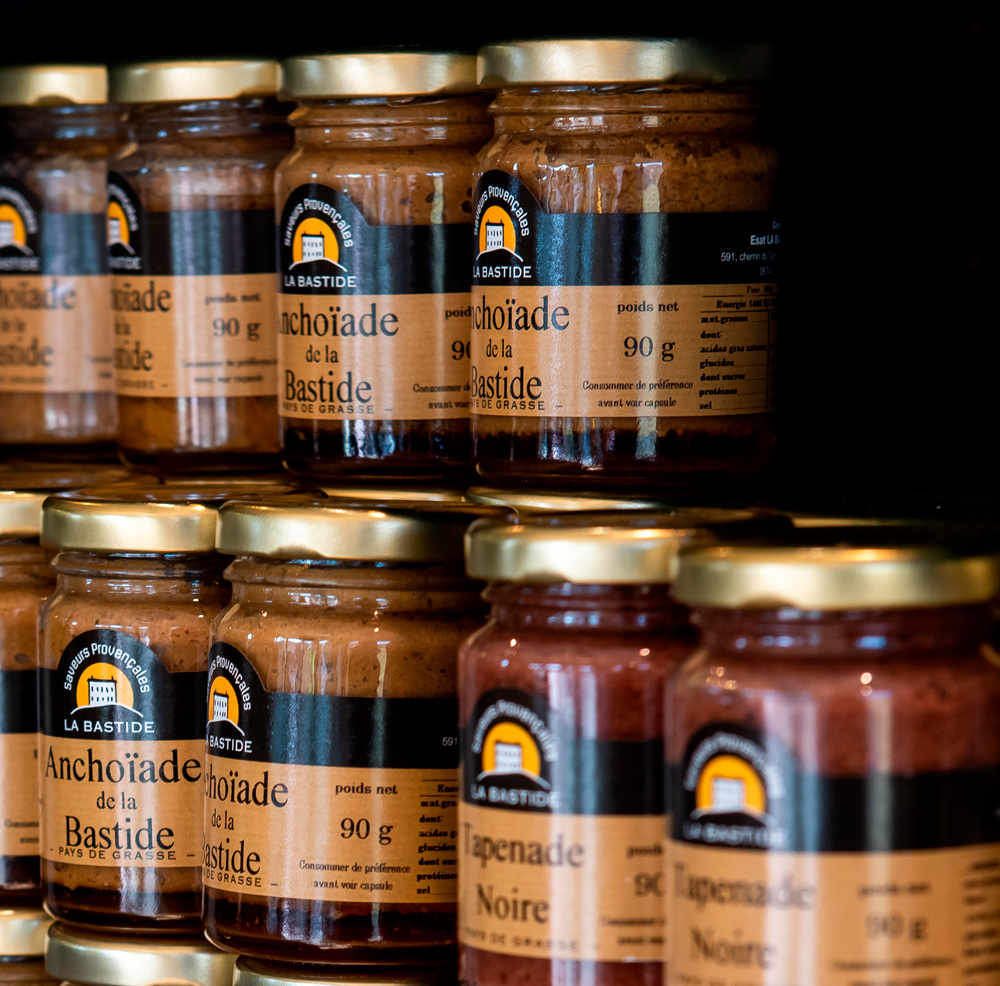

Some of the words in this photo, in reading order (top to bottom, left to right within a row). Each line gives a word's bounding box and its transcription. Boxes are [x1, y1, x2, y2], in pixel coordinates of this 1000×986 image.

[482, 266, 532, 278] BASTIDE
[284, 275, 296, 287] LA
[298, 276, 357, 288] BASTIDE
[445, 306, 471, 320] poid
[617, 301, 654, 314] poids
[658, 302, 679, 312] net
[212, 318, 240, 337] 90
[247, 322, 261, 341] g
[306, 345, 321, 363] de
[325, 345, 339, 363] la
[486, 339, 498, 357] de
[501, 339, 513, 358] la
[624, 336, 653, 357] 90
[661, 342, 675, 362] g
[700, 359, 734, 368] glucides
[285, 369, 372, 404] Bastide
[471, 366, 542, 400] Bastide
[583, 380, 634, 390] Consommer
[636, 380, 646, 390] de
[649, 379, 693, 391] préférence
[699, 386, 737, 397] protéines
[301, 404, 314, 413] DE
[319, 404, 374, 415] GRASSE
[482, 400, 492, 408] DE
[496, 400, 545, 410] GRASSE
[598, 399, 623, 407] avant
[625, 398, 642, 407] voir
[645, 397, 677, 409] capsule
[91, 643, 150, 693] Provençales
[64, 719, 79, 731] LA
[84, 721, 154, 733] BASTIDE
[210, 735, 252, 753] BASTIDE
[45, 745, 202, 783] Anchoïade
[335, 784, 372, 796] poids
[376, 784, 398, 795] net
[96, 791, 115, 810] de
[121, 791, 137, 810] la
[211, 808, 221, 828] de
[224, 810, 234, 830] la
[64, 815, 174, 851] Bastide
[340, 818, 370, 840] 90
[378, 824, 394, 846] g
[463, 822, 584, 869] Tapenade
[59, 846, 83, 858] PAYS
[89, 848, 106, 860] DE
[112, 850, 176, 861] GRASSE
[299, 859, 349, 873] Consommer
[351, 861, 362, 872] de
[365, 861, 411, 874] préférence
[218, 872, 261, 887] GRASSE
[313, 880, 339, 889] avant
[341, 880, 357, 890] voir
[363, 882, 393, 892] capsule
[475, 882, 549, 924] Noire
